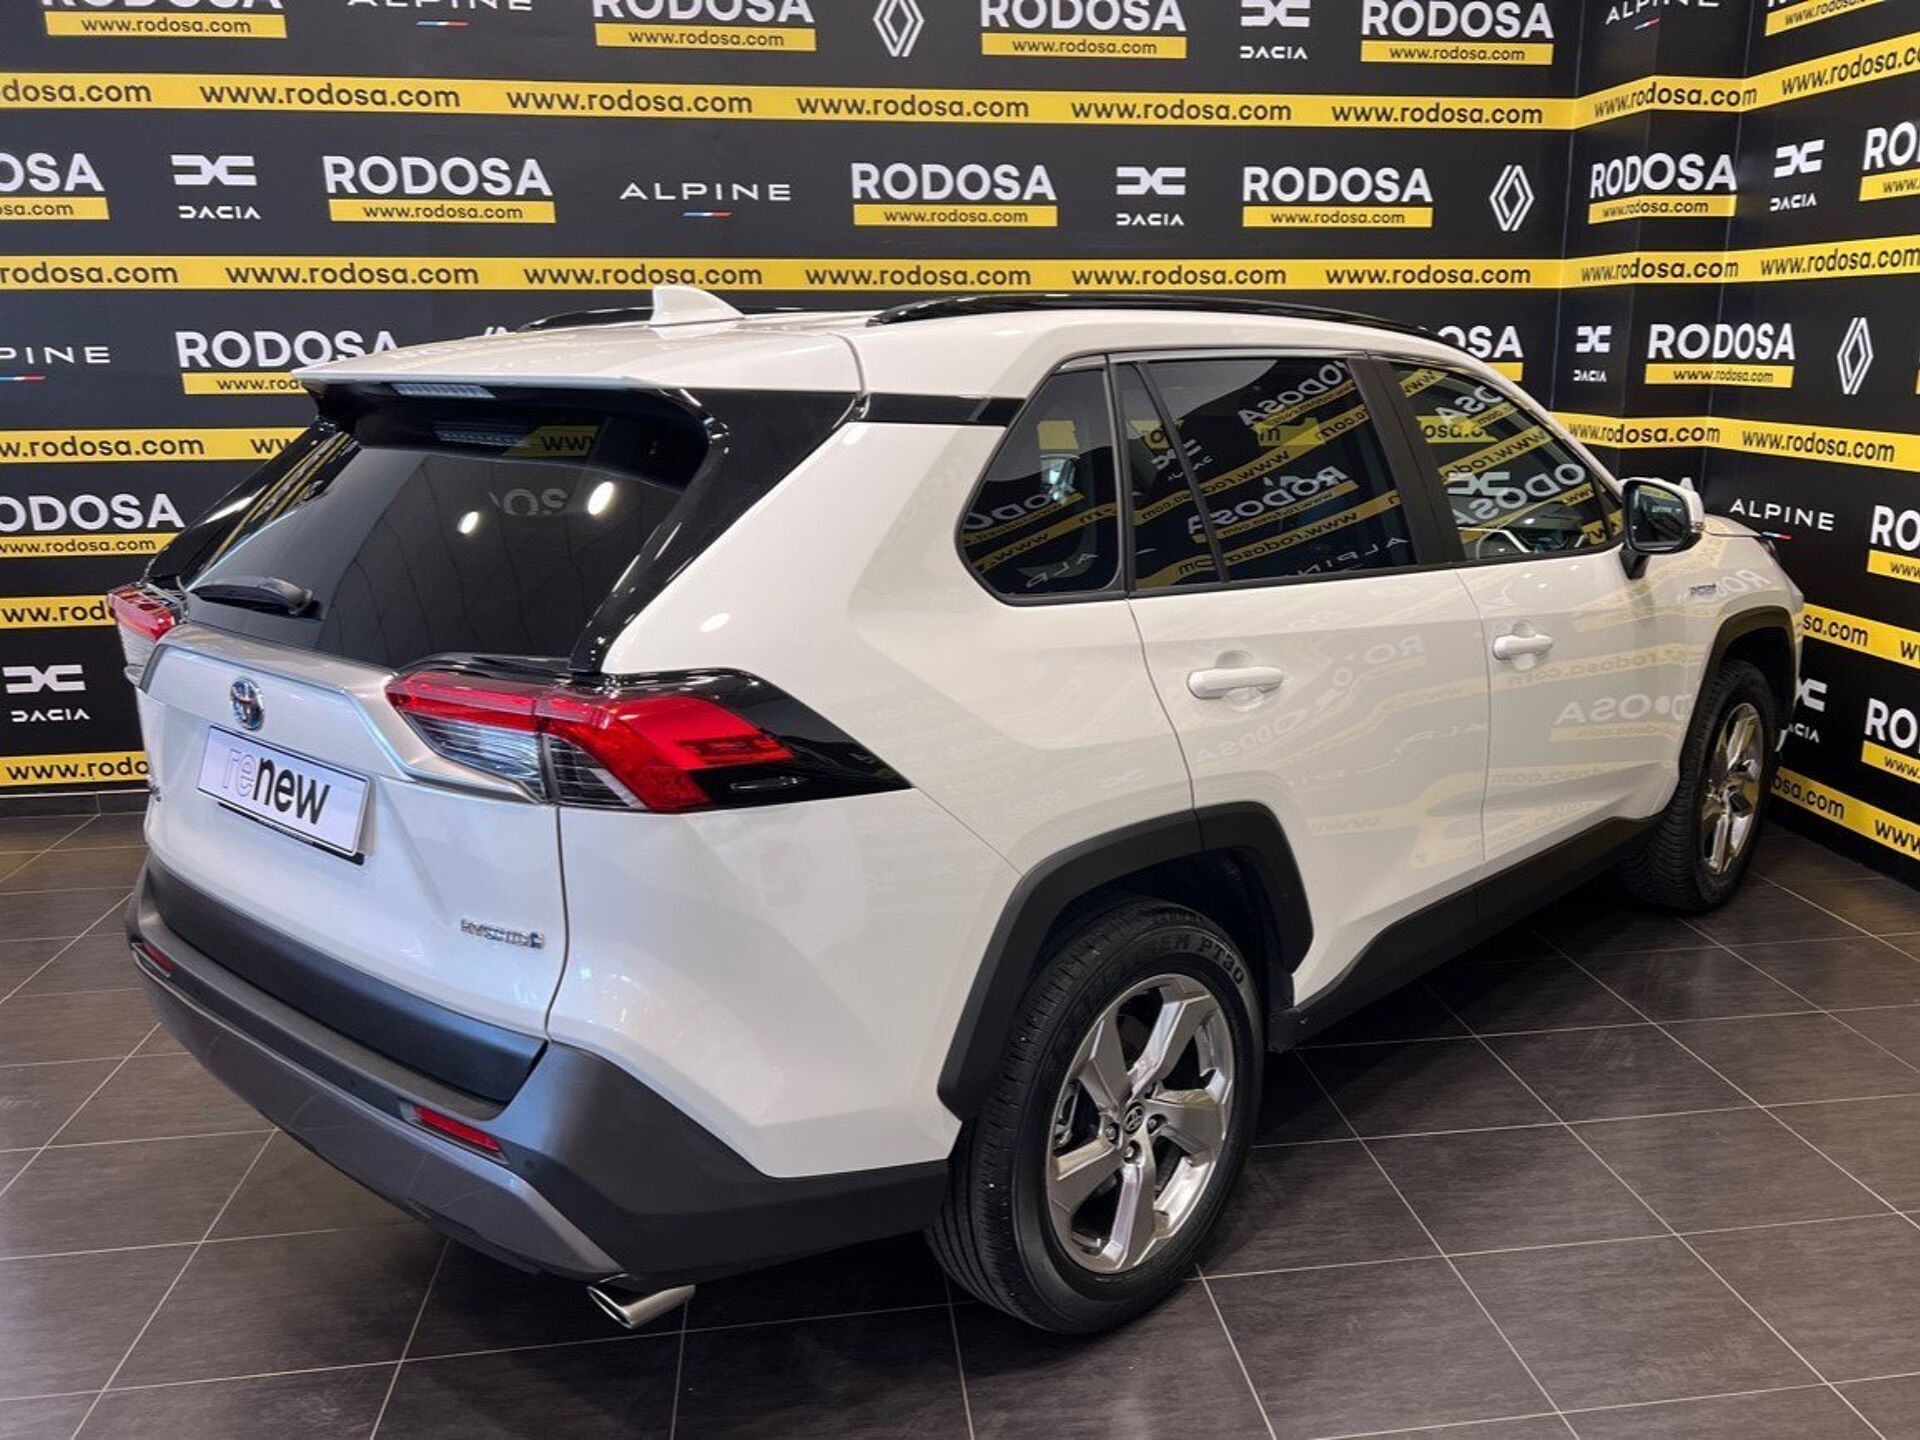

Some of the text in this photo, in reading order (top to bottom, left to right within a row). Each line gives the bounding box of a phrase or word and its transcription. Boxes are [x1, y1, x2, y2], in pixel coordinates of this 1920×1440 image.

[81, 17, 251, 33] www.rodosa.com
[980, 0, 1186, 31] RODOSA
[1361, 0, 1554, 38] RODOSA
[628, 30, 784, 47] www.rodosa.com
[1012, 39, 1157, 54] www.rodosa.com
[1239, 45, 1308, 60] DACIA
[1389, 46, 1525, 61] www.rodosa.com
[2, 79, 152, 102] dosa.com
[199, 82, 460, 108] www.rodosa.com
[1594, 82, 1757, 118] www.rodosa.com
[506, 90, 752, 114] www.rodosa.com
[797, 95, 1029, 118] www.rodosa.com
[1071, 99, 1291, 121] www.rodosa.com
[1331, 102, 1542, 124] www.rodosa.com
[322, 155, 553, 196] RODOSA
[851, 162, 1057, 200] RODOSA
[1243, 166, 1433, 202] RODOSA
[1590, 153, 1737, 199] RODOSA
[620, 182, 791, 201] ALPINE
[179, 205, 260, 219] DACIA
[363, 204, 523, 220] www.rodosa.com
[1602, 200, 1709, 218] www.rodosa.com
[1770, 193, 1817, 212] DACIA
[884, 208, 1028, 223] www.rodosa.com
[1117, 213, 1184, 226] DACIA
[1271, 211, 1405, 225] www.rodosa.com
[1581, 258, 1738, 281] www.rodosa.com
[1761, 248, 1920, 276] www.rodosa.com
[225, 264, 479, 284] www.rodosa.com
[523, 265, 763, 286] www.rodosa.com
[805, 266, 1032, 286] www.rodosa.com
[1072, 267, 1287, 286] www.rodosa.com
[1326, 266, 1531, 285] www.rodosa.com
[1648, 323, 1795, 360] RODOSA
[1673, 367, 1774, 384] www.rodosa.com
[1568, 421, 1720, 443] www.rodosa.com
[1742, 430, 1896, 463] www.rodosa.com
[1729, 498, 1835, 531] ALPINE
[11, 708, 91, 723] DACIA
[222, 748, 330, 826] renew
